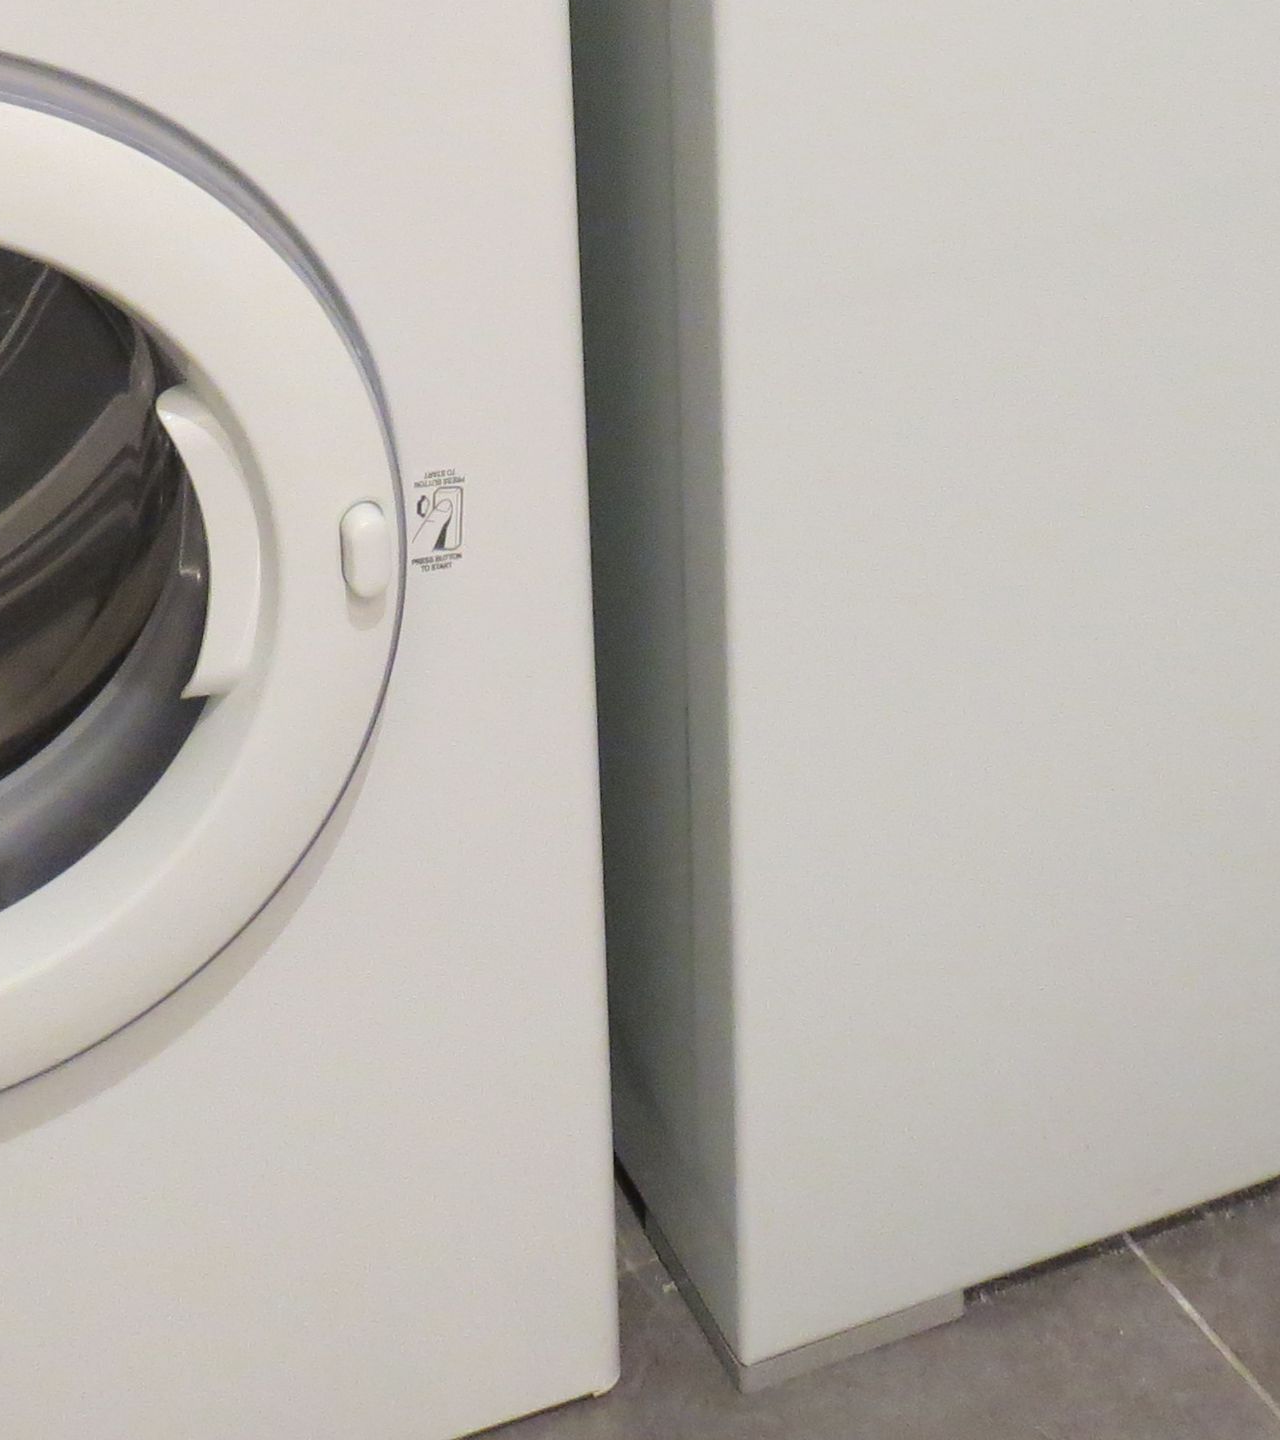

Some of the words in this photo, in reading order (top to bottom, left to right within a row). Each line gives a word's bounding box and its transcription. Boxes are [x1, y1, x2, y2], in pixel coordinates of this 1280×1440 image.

[411, 556, 434, 566] PRESS
[435, 553, 463, 562] BUTTON
[420, 564, 431, 573] TO
[431, 561, 453, 572] START
